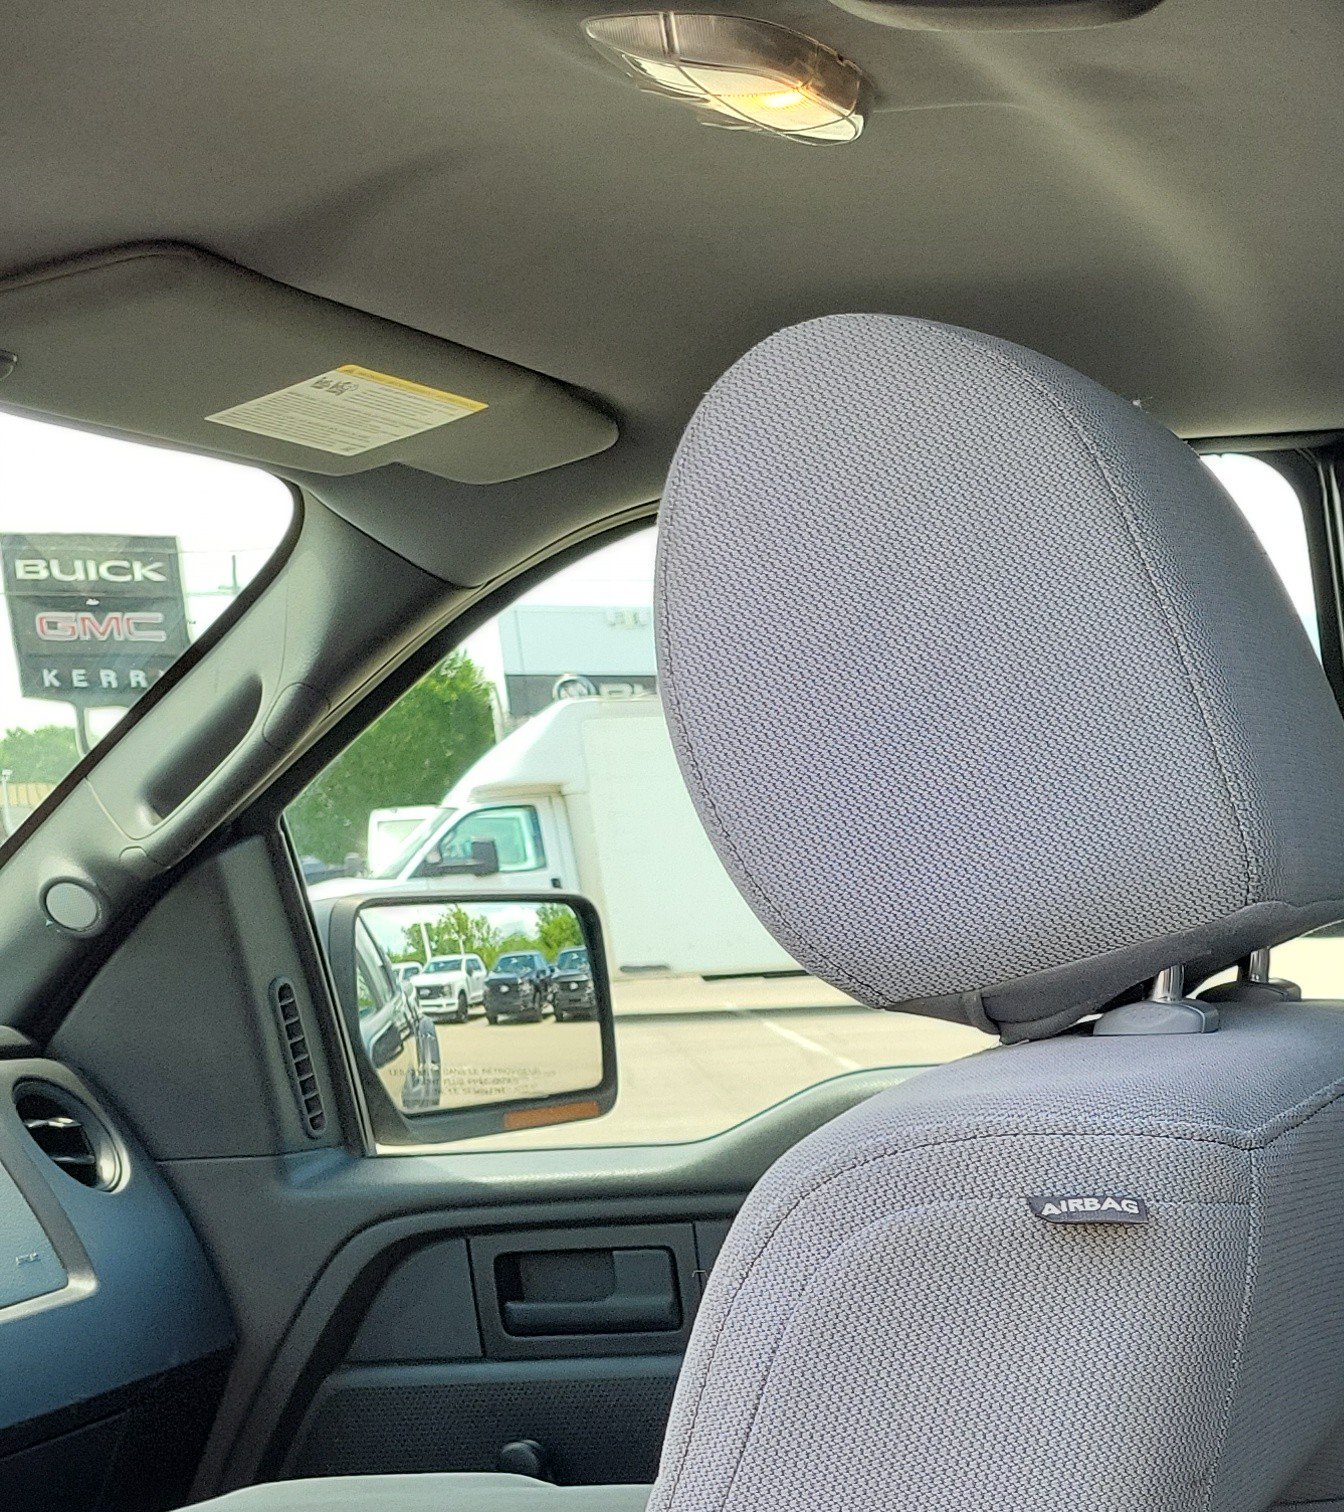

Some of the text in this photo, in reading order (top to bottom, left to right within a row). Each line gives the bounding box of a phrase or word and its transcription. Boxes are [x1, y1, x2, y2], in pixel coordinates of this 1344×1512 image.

[14, 559, 168, 582] BUICK
[35, 612, 167, 642] GMC
[42, 668, 164, 688] KERR
[1041, 1197, 1140, 1215] AIRBAG
